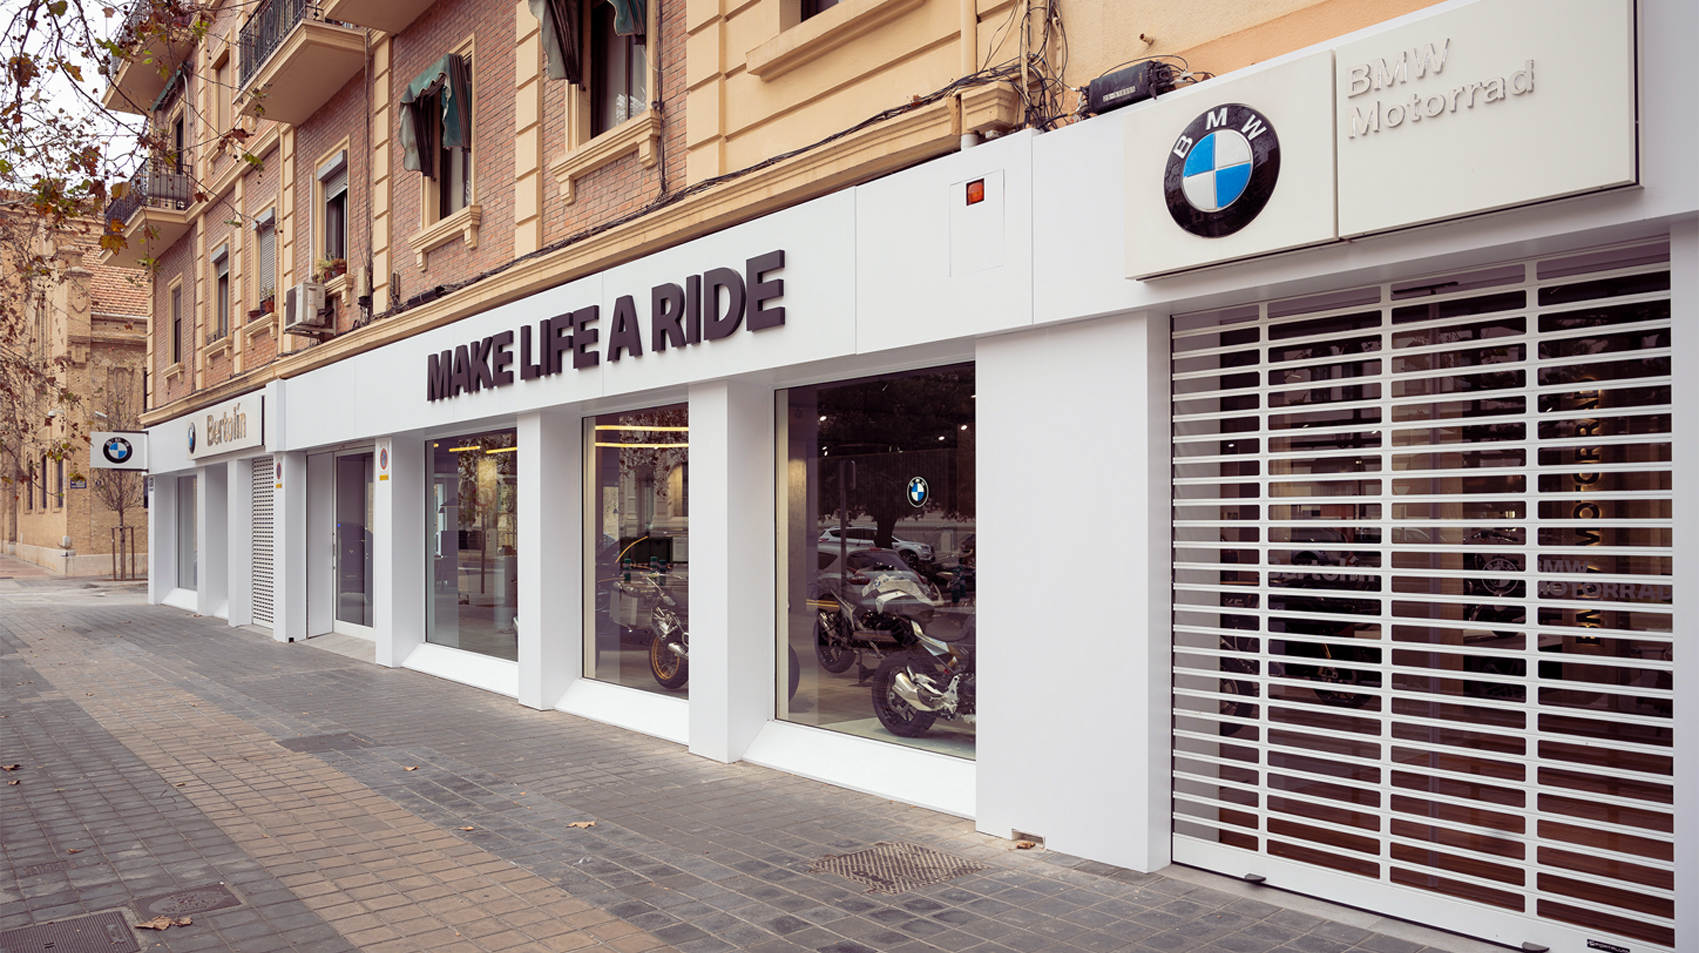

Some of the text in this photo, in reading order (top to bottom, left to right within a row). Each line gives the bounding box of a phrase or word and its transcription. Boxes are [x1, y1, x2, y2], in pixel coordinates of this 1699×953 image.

[1346, 38, 1451, 98] BMW
[1347, 59, 1535, 138] Motorrad
[1172, 107, 1267, 159] BMW
[427, 249, 785, 401] MAKE LIFE A RIDE
[207, 402, 247, 447] Bertolín
